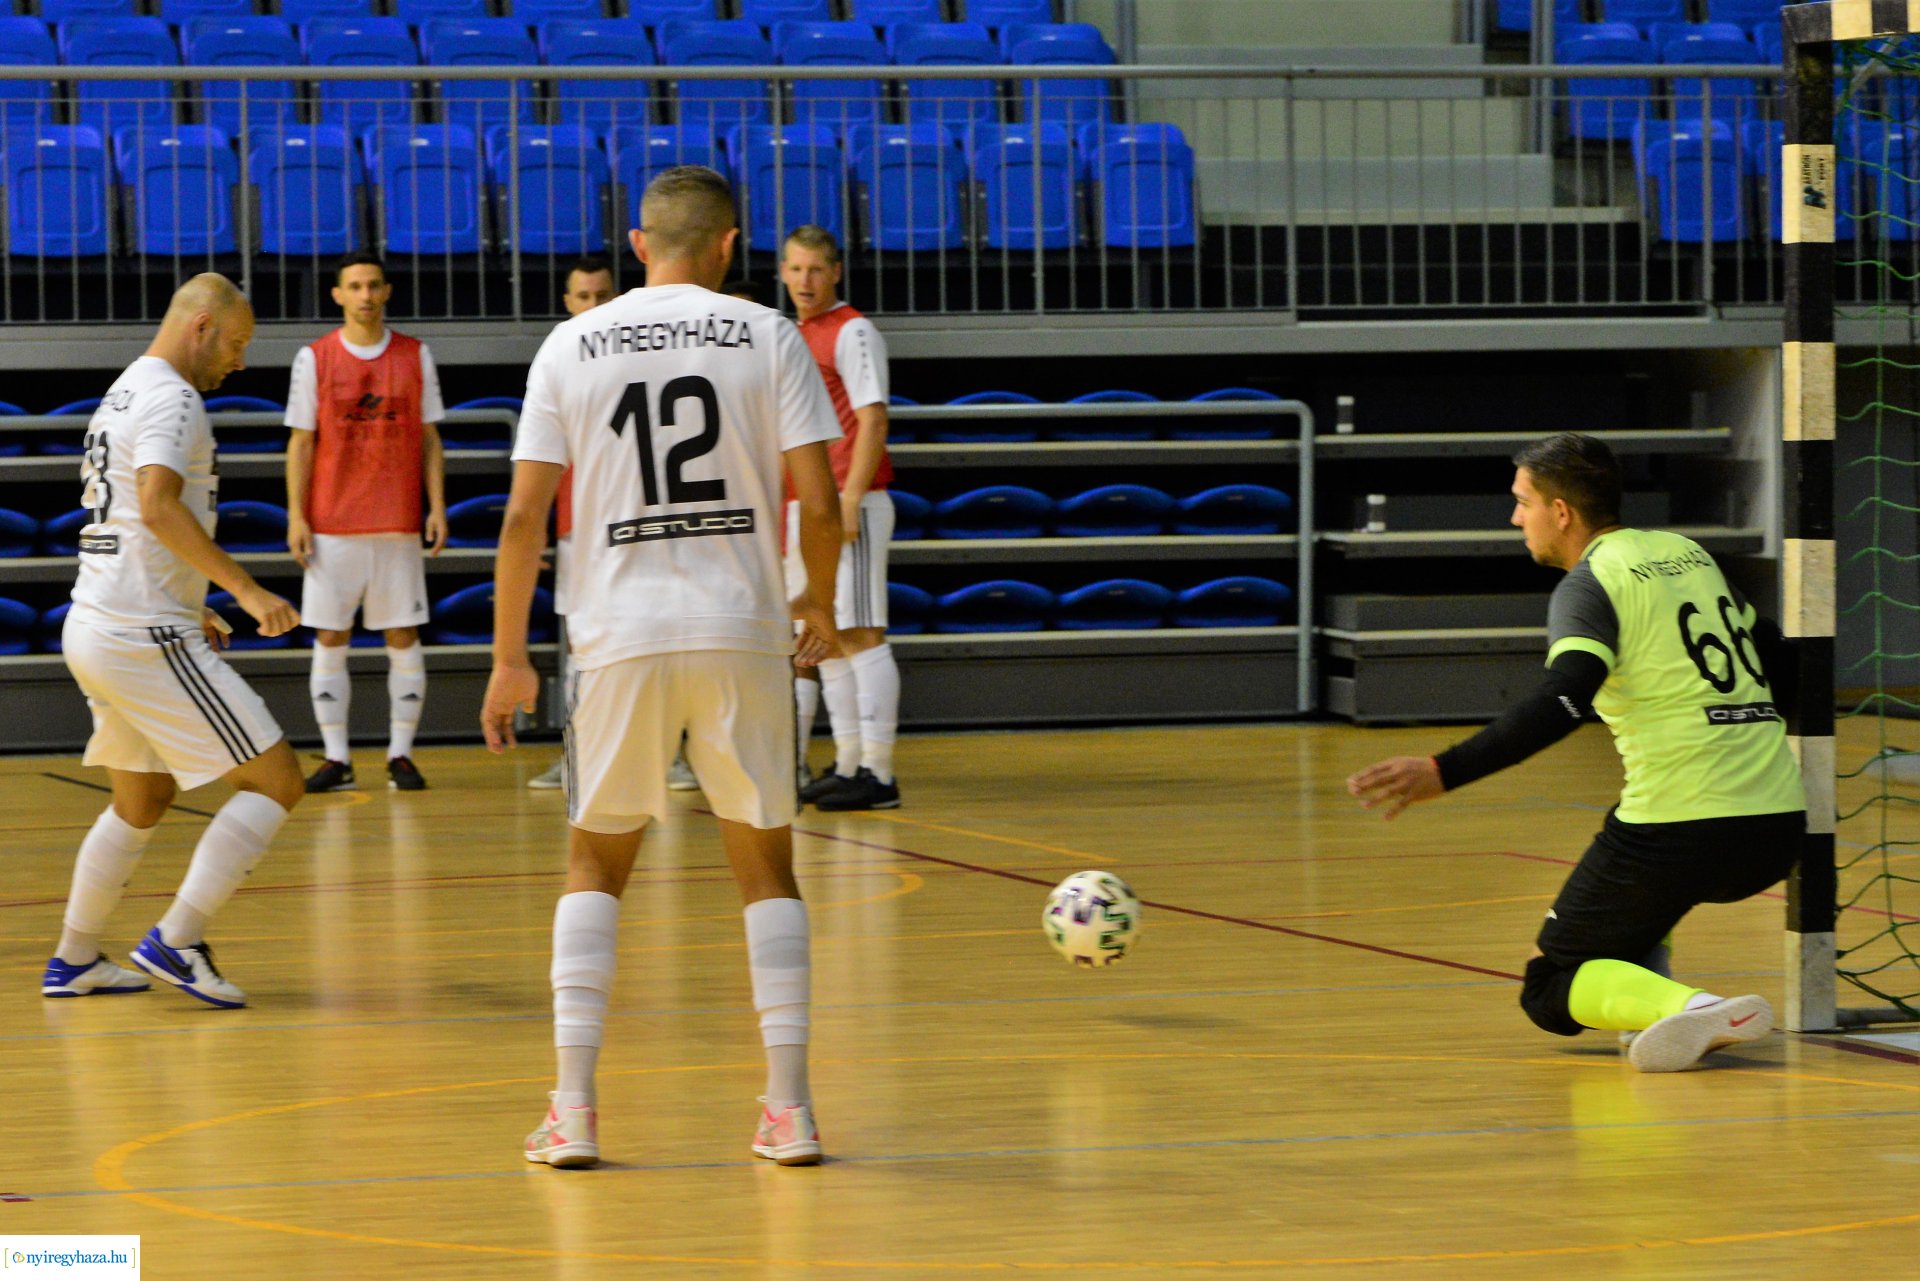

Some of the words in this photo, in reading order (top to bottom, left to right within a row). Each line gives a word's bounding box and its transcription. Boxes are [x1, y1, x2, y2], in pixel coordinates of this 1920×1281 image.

[579, 313, 754, 361] NYÍREGYHÁZA
[609, 375, 726, 506] 12
[1678, 595, 1766, 693] 66
